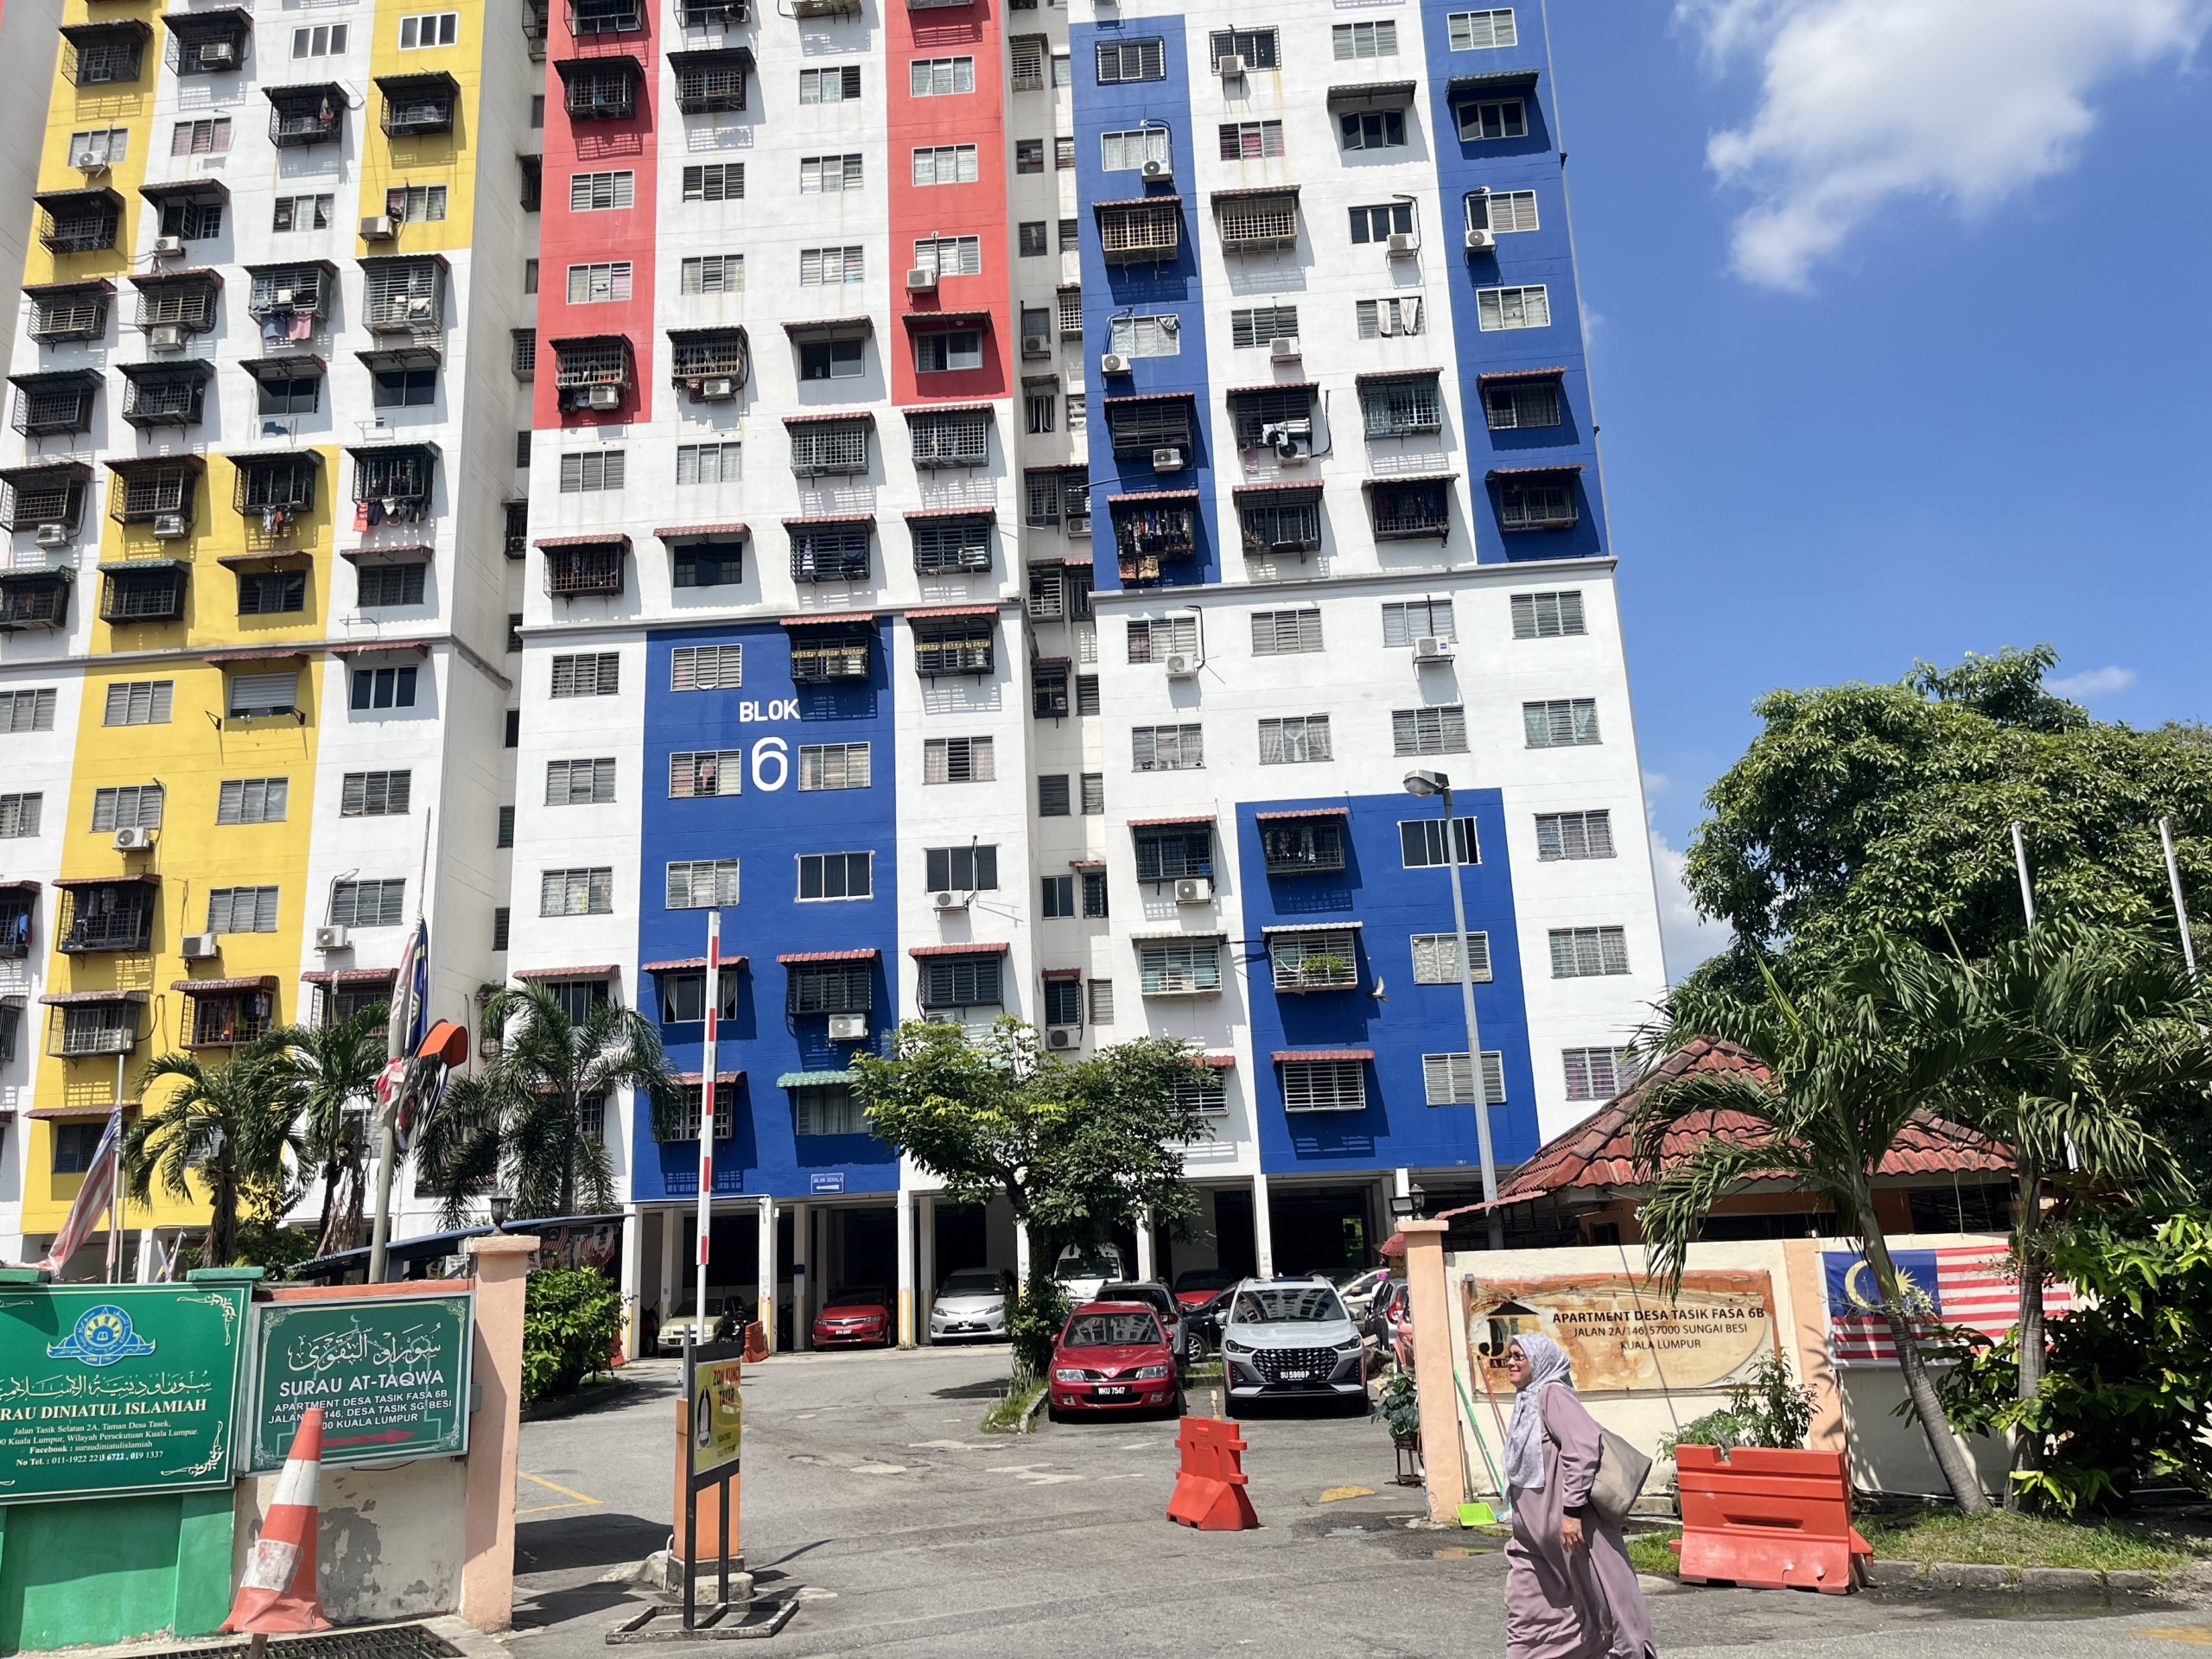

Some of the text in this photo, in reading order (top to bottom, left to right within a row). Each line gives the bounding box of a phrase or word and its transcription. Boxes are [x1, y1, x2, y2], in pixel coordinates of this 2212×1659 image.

[739, 699, 801, 722] BLOK
[751, 736, 789, 791] 6
[1553, 1307, 1765, 1324] APARTMENT DESA TASIK FASA 6B
[1573, 1327, 1605, 1338] JALAN
[1649, 1325, 1681, 1335] 57000
[1682, 1324, 1723, 1334] SUNGAI
[1726, 1323, 1748, 1333] BESI
[1620, 1338, 1702, 1351] KUALA LUMPUR
[279, 1369, 445, 1398] SURAU AT-TAQWA
[713, 1369, 724, 1386] ZON
[719, 1387, 734, 1407] TAYAR
[1097, 1386, 1126, 1395] WKU 7547
[41, 1402, 122, 1420] DINIATUL
[124, 1398, 207, 1415] ISLAMIAH
[273, 1389, 448, 1413] APARTMENT DESA TASIK FASA 6B
[268, 1413, 305, 1424] JALAN
[346, 1406, 376, 1417] DESA
[378, 1403, 408, 1414] TASIK
[429, 1399, 452, 1409] BESI
[35, 1426, 55, 1434] Tasik
[57, 1425, 85, 1433] Selatan
[102, 1422, 127, 1431] Taman
[336, 1417, 372, 1429] KUALA
[374, 1413, 418, 1426] LUMPUR
[8, 1436, 31, 1446] Kuala
[67, 1433, 98, 1443] Wilayah
[99, 1431, 143, 1441] Persekutuan
[29, 1445, 68, 1454] Facebook
[52, 1455, 87, 1465] 011-1922
[146, 1450, 164, 1459] 1337
